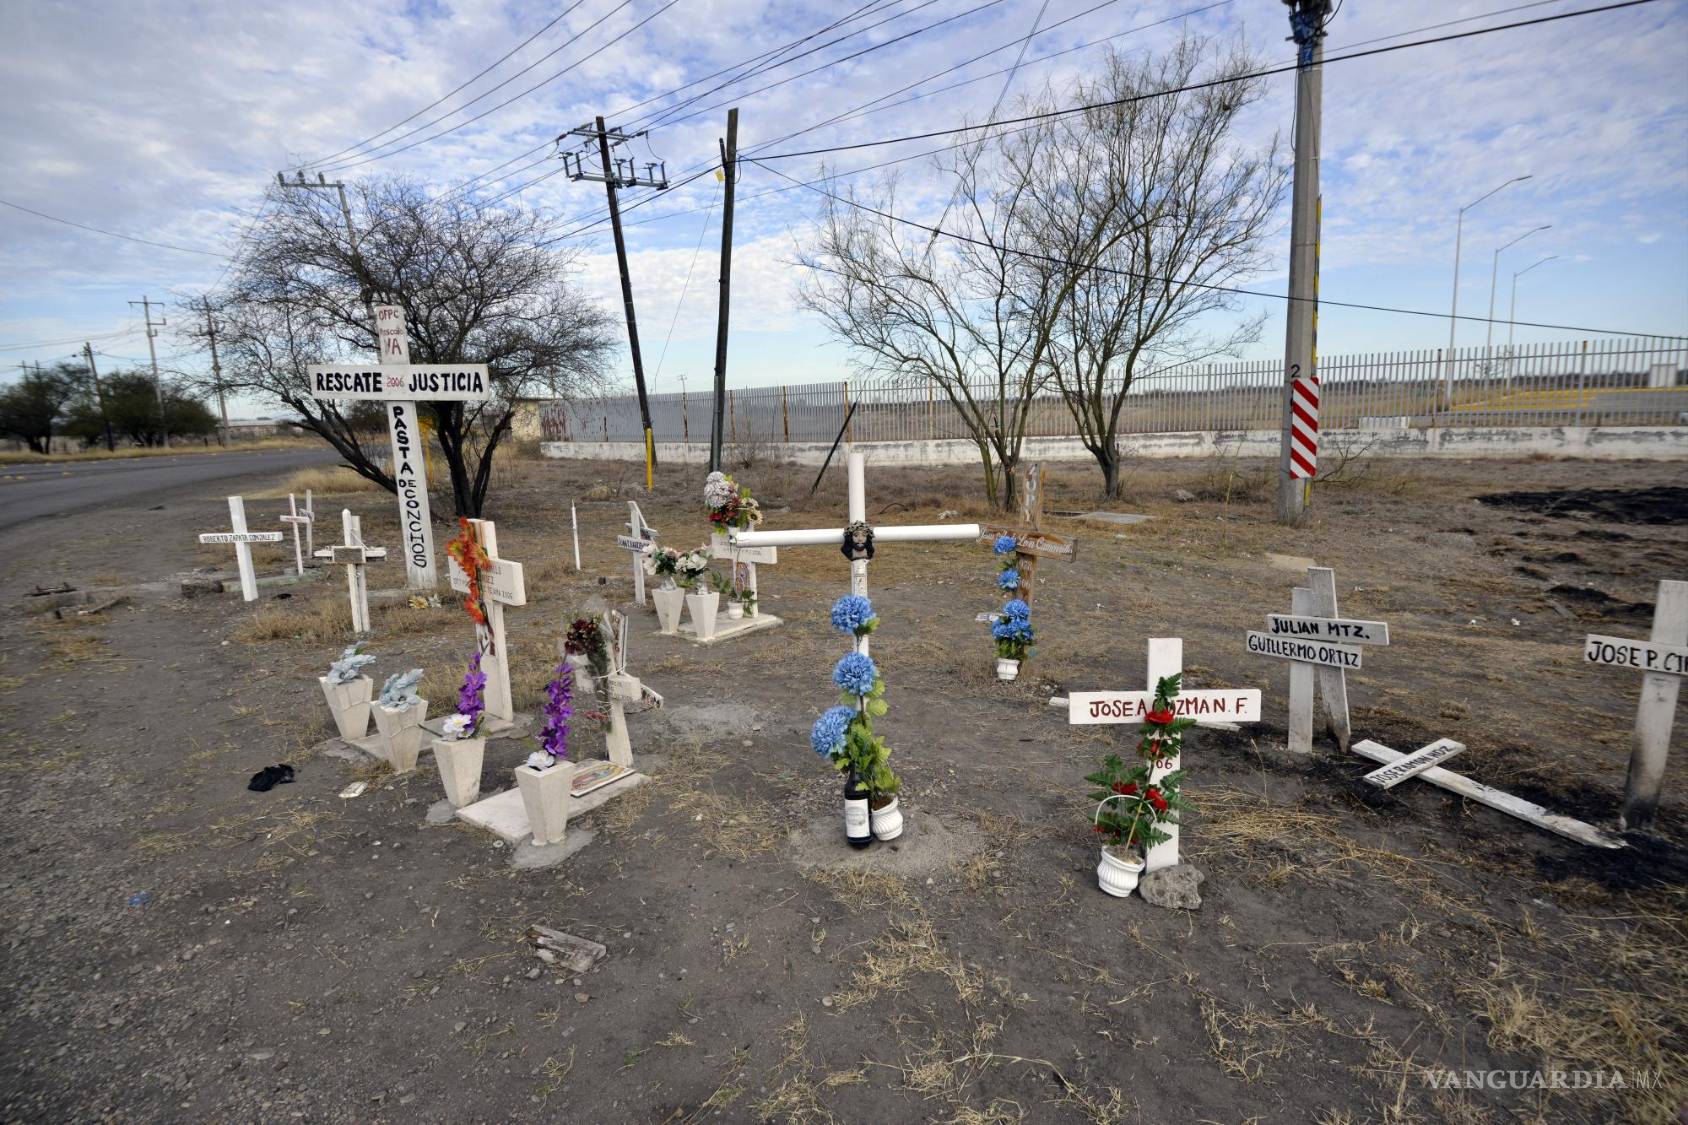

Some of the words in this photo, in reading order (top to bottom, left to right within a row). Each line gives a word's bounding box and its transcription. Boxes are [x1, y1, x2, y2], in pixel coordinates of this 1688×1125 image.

[1290, 364, 1300, 378] 2
[316, 372, 383, 392] RESCATE
[409, 372, 484, 393] JUSTICIA
[393, 406, 414, 475] PASTA
[399, 479, 417, 488] DE
[404, 489, 428, 569] CONCHOS
[1271, 617, 1319, 634] JULIAN
[1328, 621, 1370, 639] MTZ.
[1248, 634, 1316, 660] GUILLERMO
[1319, 646, 1360, 667] ORTIZ
[1588, 641, 1641, 668] JOSE
[1156, 759, 1173, 769] 06
